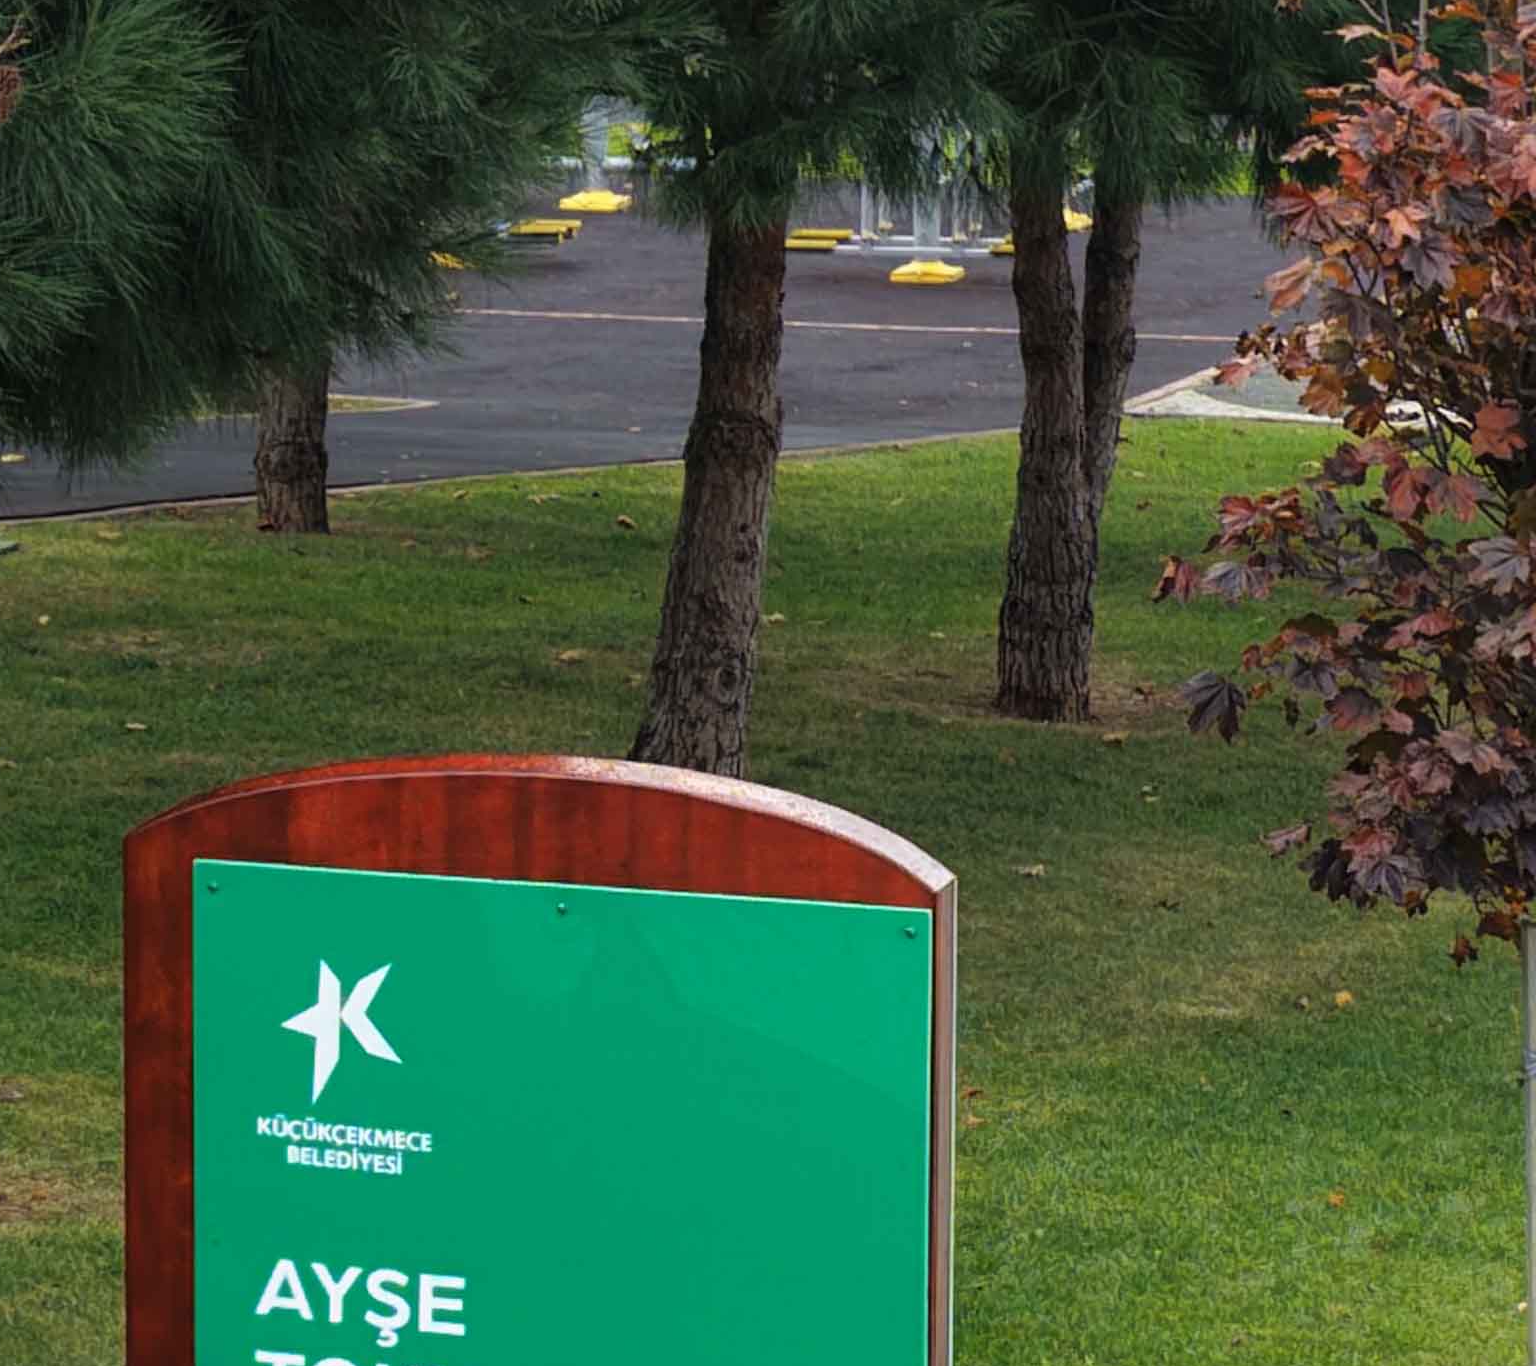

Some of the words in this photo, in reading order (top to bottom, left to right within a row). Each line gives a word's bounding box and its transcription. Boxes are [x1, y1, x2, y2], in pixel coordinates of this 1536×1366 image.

[256, 1114, 433, 1153] KÜÇÜKÇEKMECE
[286, 1144, 403, 1176] BELEDİYESİ
[255, 1258, 466, 1348] AYŞE
